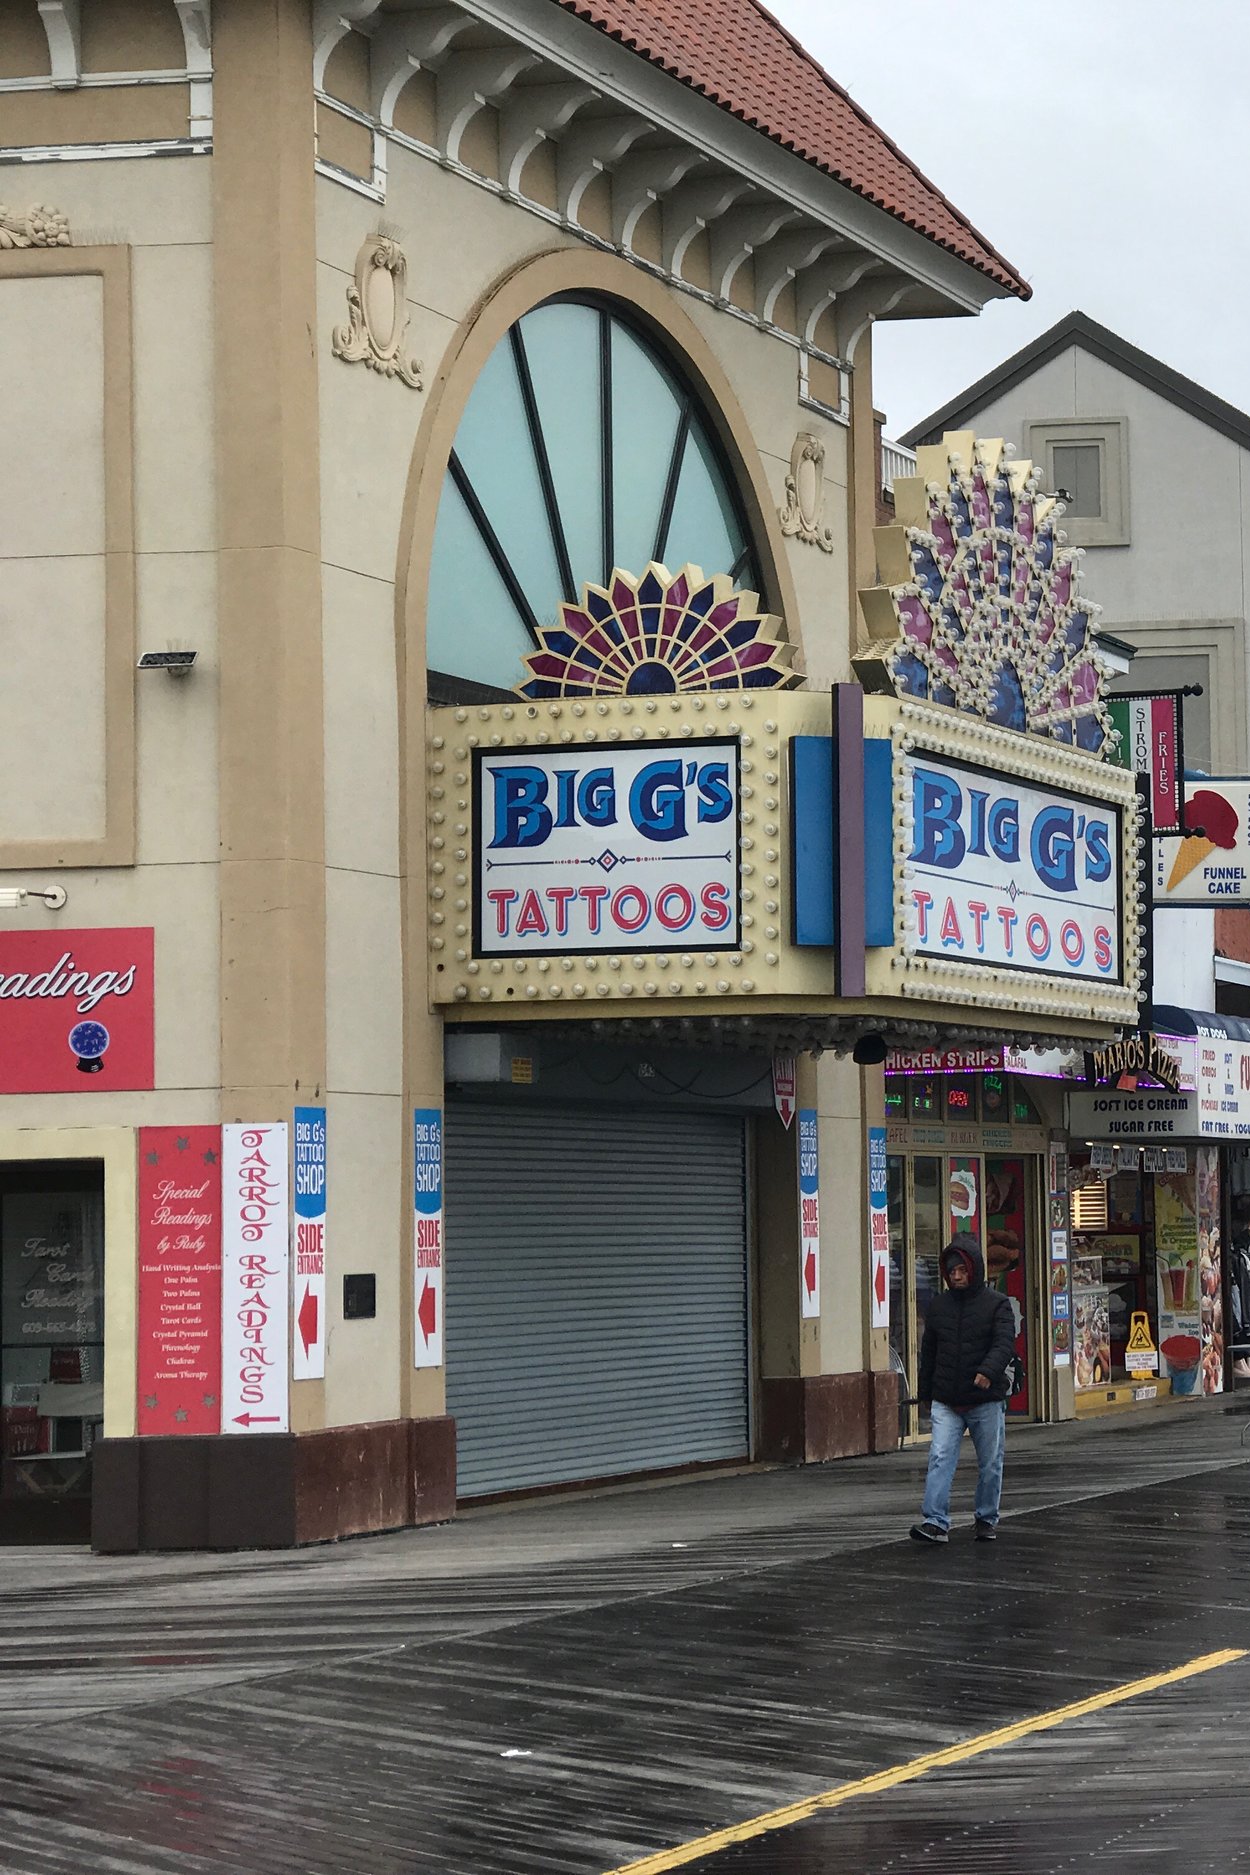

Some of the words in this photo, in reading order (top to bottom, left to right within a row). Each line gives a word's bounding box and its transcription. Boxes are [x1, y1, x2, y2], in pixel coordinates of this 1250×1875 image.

[1158, 731, 1169, 795] FRIES
[486, 765, 618, 849] BIG
[628, 758, 734, 843] G'S
[906, 766, 1021, 870] BIG
[1029, 805, 1112, 893] G'S
[1203, 867, 1247, 880] FUNNEL
[1207, 882, 1241, 894] CAKE
[486, 881, 732, 938] TATTOOS
[911, 889, 1113, 974] TATTOOS
[0, 951, 137, 1014] adings
[946, 1051, 999, 1067] STRIPS
[1092, 1039, 1145, 1088] MARIO'S
[1093, 1100, 1120, 1111] SOFT
[1123, 1100, 1143, 1111] ICE
[1146, 1098, 1188, 1110] CREAM
[297, 1122, 310, 1142] BIG
[416, 1123, 429, 1142] BIG
[1108, 1120, 1145, 1132] SUGAR
[1147, 1120, 1174, 1132] FREE
[1201, 1120, 1213, 1132] FAT
[1214, 1121, 1229, 1133] FREE
[297, 1143, 325, 1162] TATTOO
[416, 1143, 441, 1162] TATTOO
[800, 1153, 817, 1177] SHOP
[296, 1164, 325, 1195] SHOP
[416, 1163, 441, 1193] SHOP
[870, 1170, 887, 1192] SHOP
[152, 1180, 211, 1206] Special
[150, 1206, 213, 1231] Readings
[802, 1198, 818, 1222] SIDE
[417, 1219, 440, 1248] SIDE
[872, 1213, 887, 1236] SIDE
[156, 1235, 171, 1255] by
[172, 1235, 206, 1254] Ruby
[297, 1223, 324, 1254] SIDE
[142, 1264, 162, 1272] Hand
[163, 1264, 191, 1274] Writing
[297, 1254, 324, 1275] ENTRANCE
[417, 1249, 441, 1269] ENTRANCE
[180, 1276, 198, 1284] Palm
[160, 1303, 185, 1313] Crystal
[187, 1302, 202, 1310] Ball
[160, 1317, 180, 1325] Tarot
[236, 1254, 281, 1404] READINGS
[152, 1331, 177, 1340] Crystal
[179, 1330, 208, 1340] Pyramid
[161, 1344, 201, 1354] Phrenology
[179, 1371, 208, 1381] Therapy
